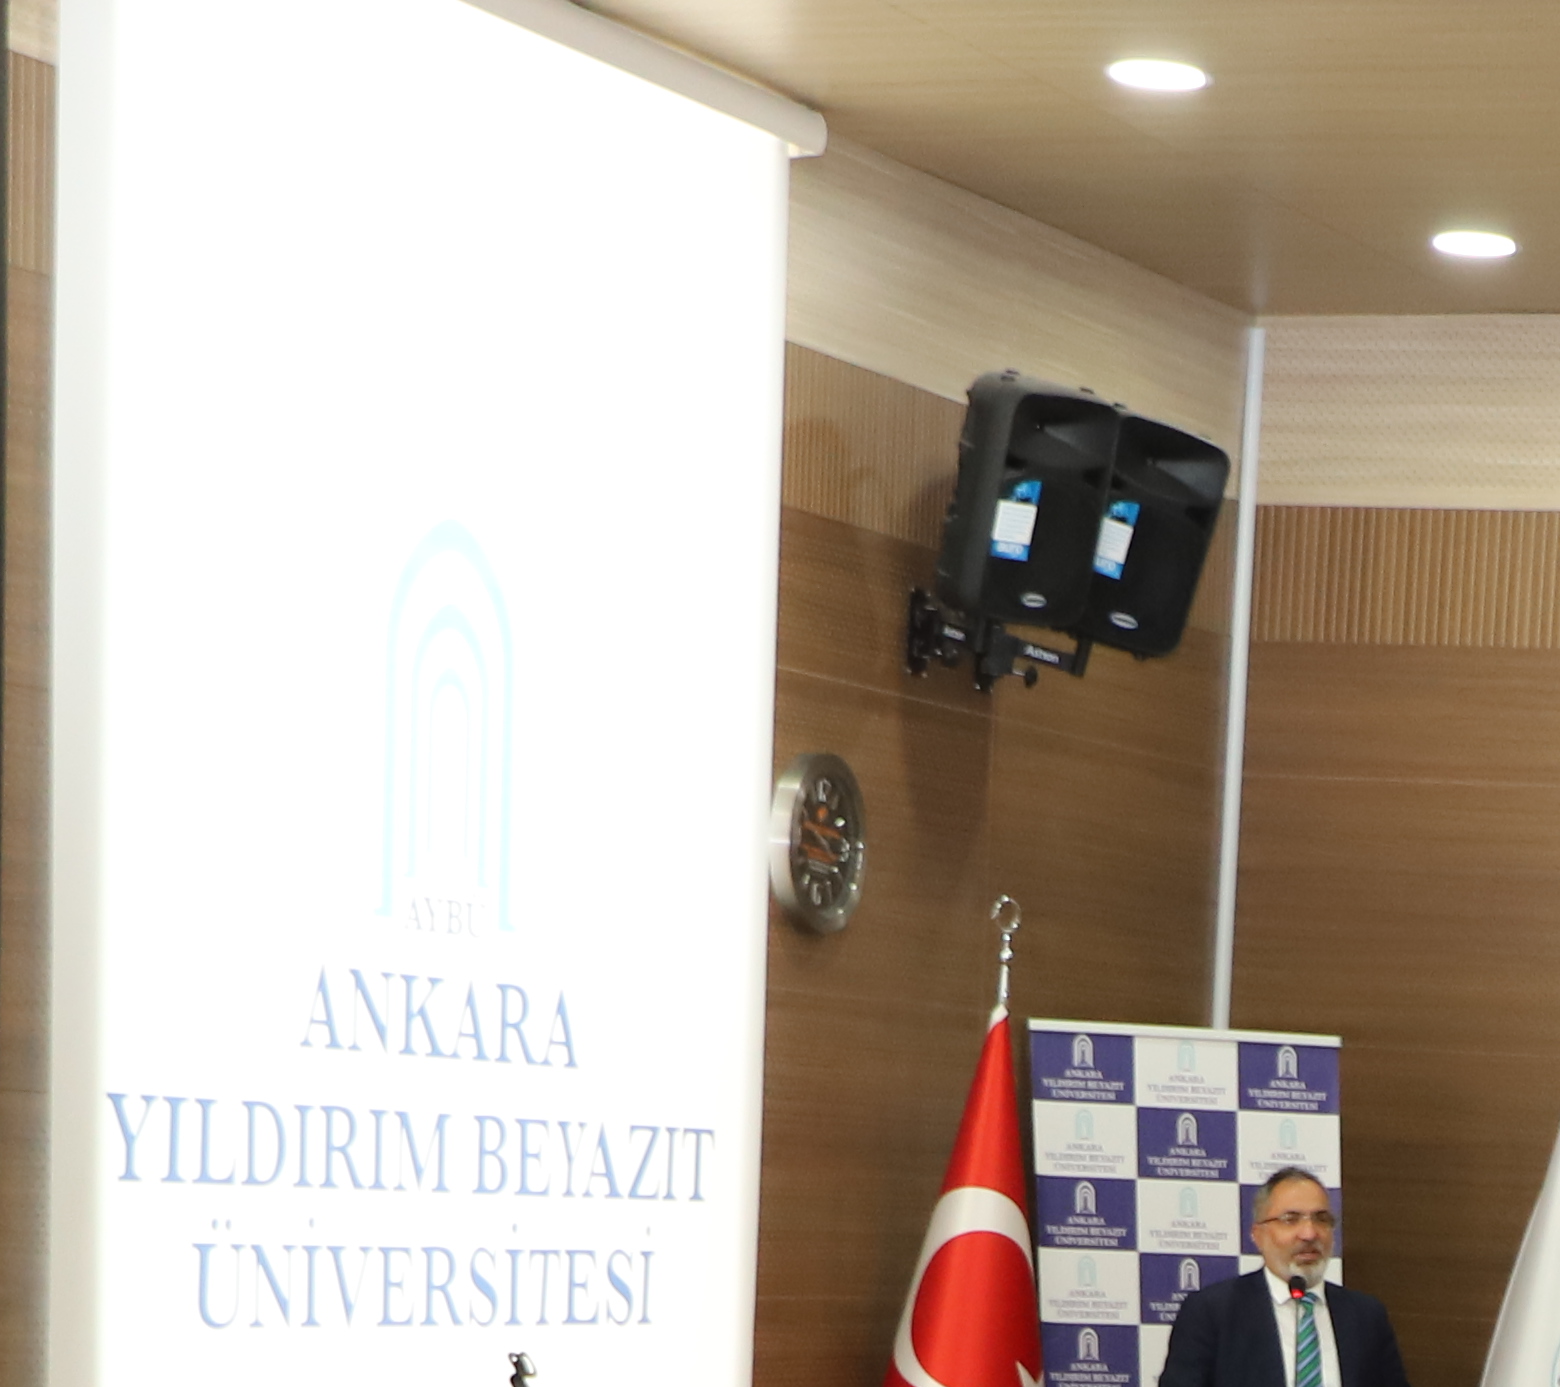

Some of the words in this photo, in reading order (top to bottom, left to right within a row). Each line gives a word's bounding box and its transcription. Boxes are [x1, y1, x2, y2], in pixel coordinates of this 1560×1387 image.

[300, 965, 579, 1069] ANKARA
[107, 1093, 451, 1192] YILDIRIM
[472, 1115, 715, 1202] BEYAZIT
[191, 1218, 655, 1330] ÜNİVERSİTESİ
